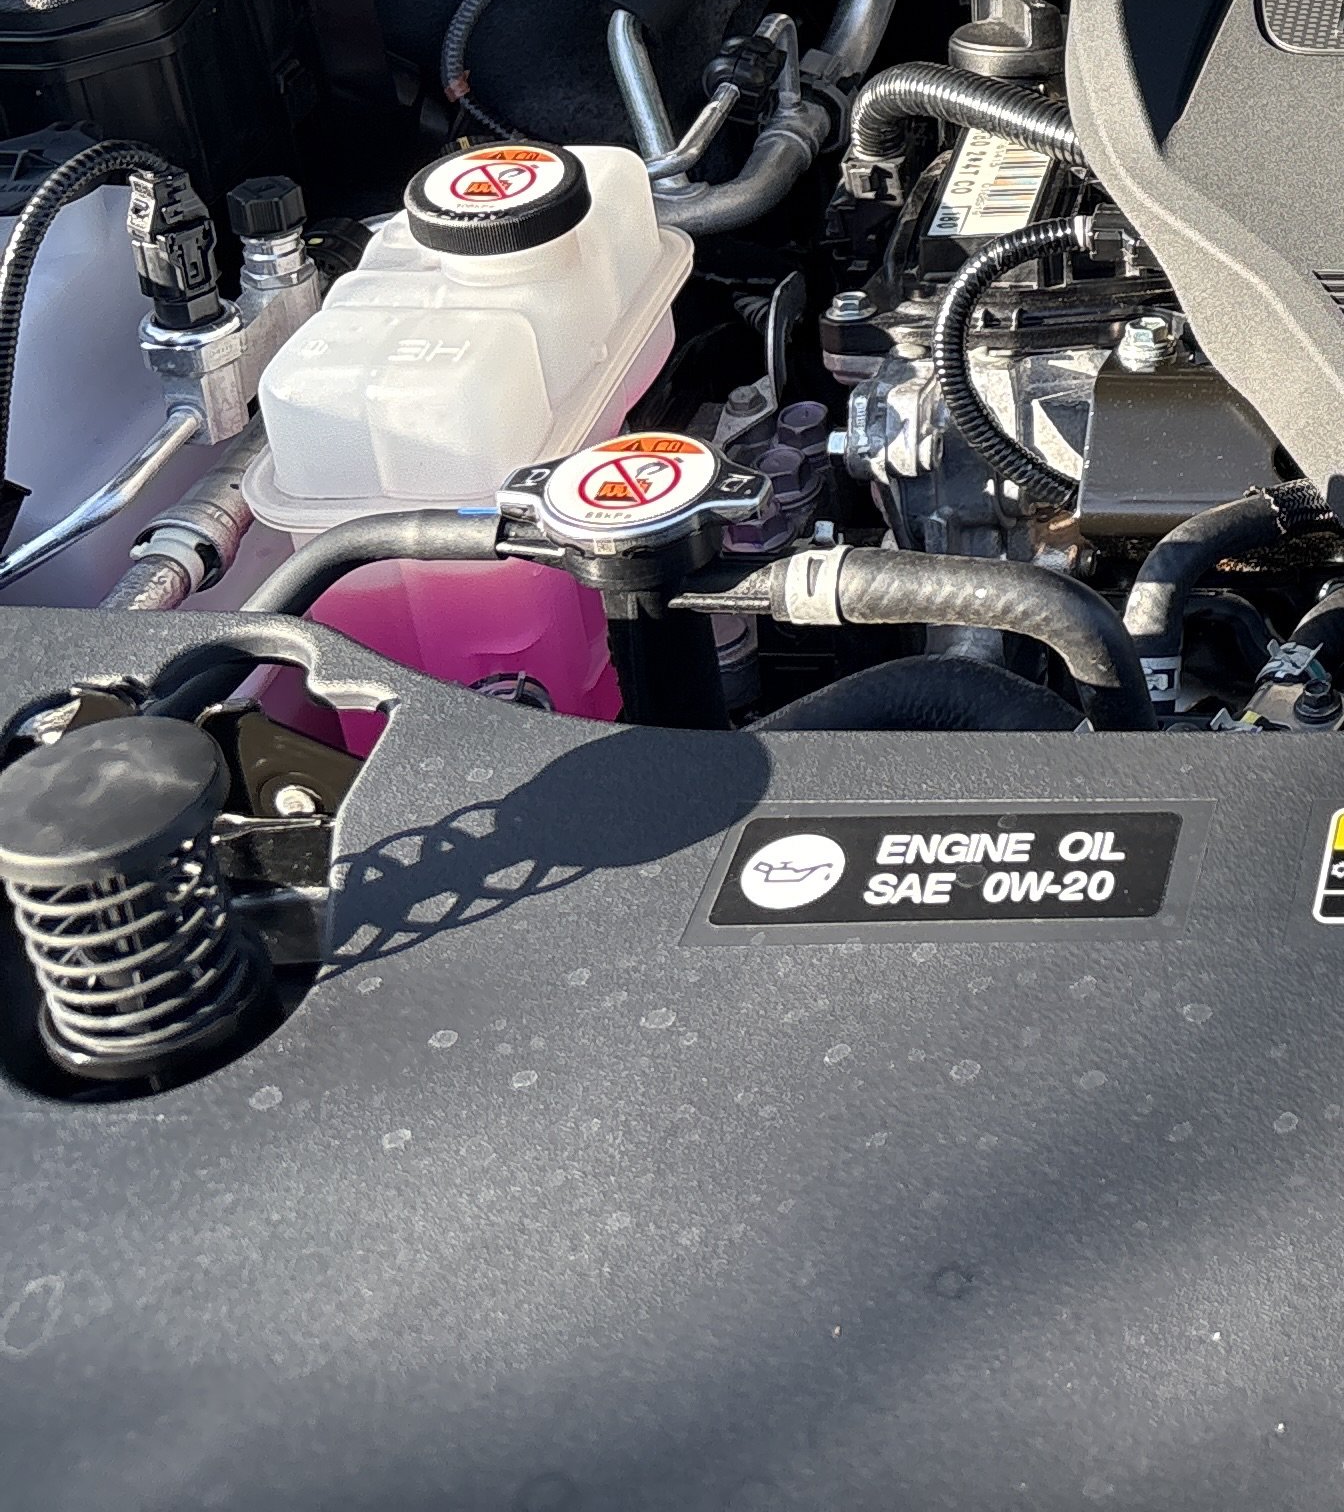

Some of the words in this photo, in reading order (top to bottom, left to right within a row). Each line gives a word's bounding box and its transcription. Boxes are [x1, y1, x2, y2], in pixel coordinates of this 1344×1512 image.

[876, 832, 1035, 865] ENGINE
[1058, 830, 1126, 862] OIL
[863, 872, 957, 905] SAE
[982, 870, 1116, 903] 0W-20
